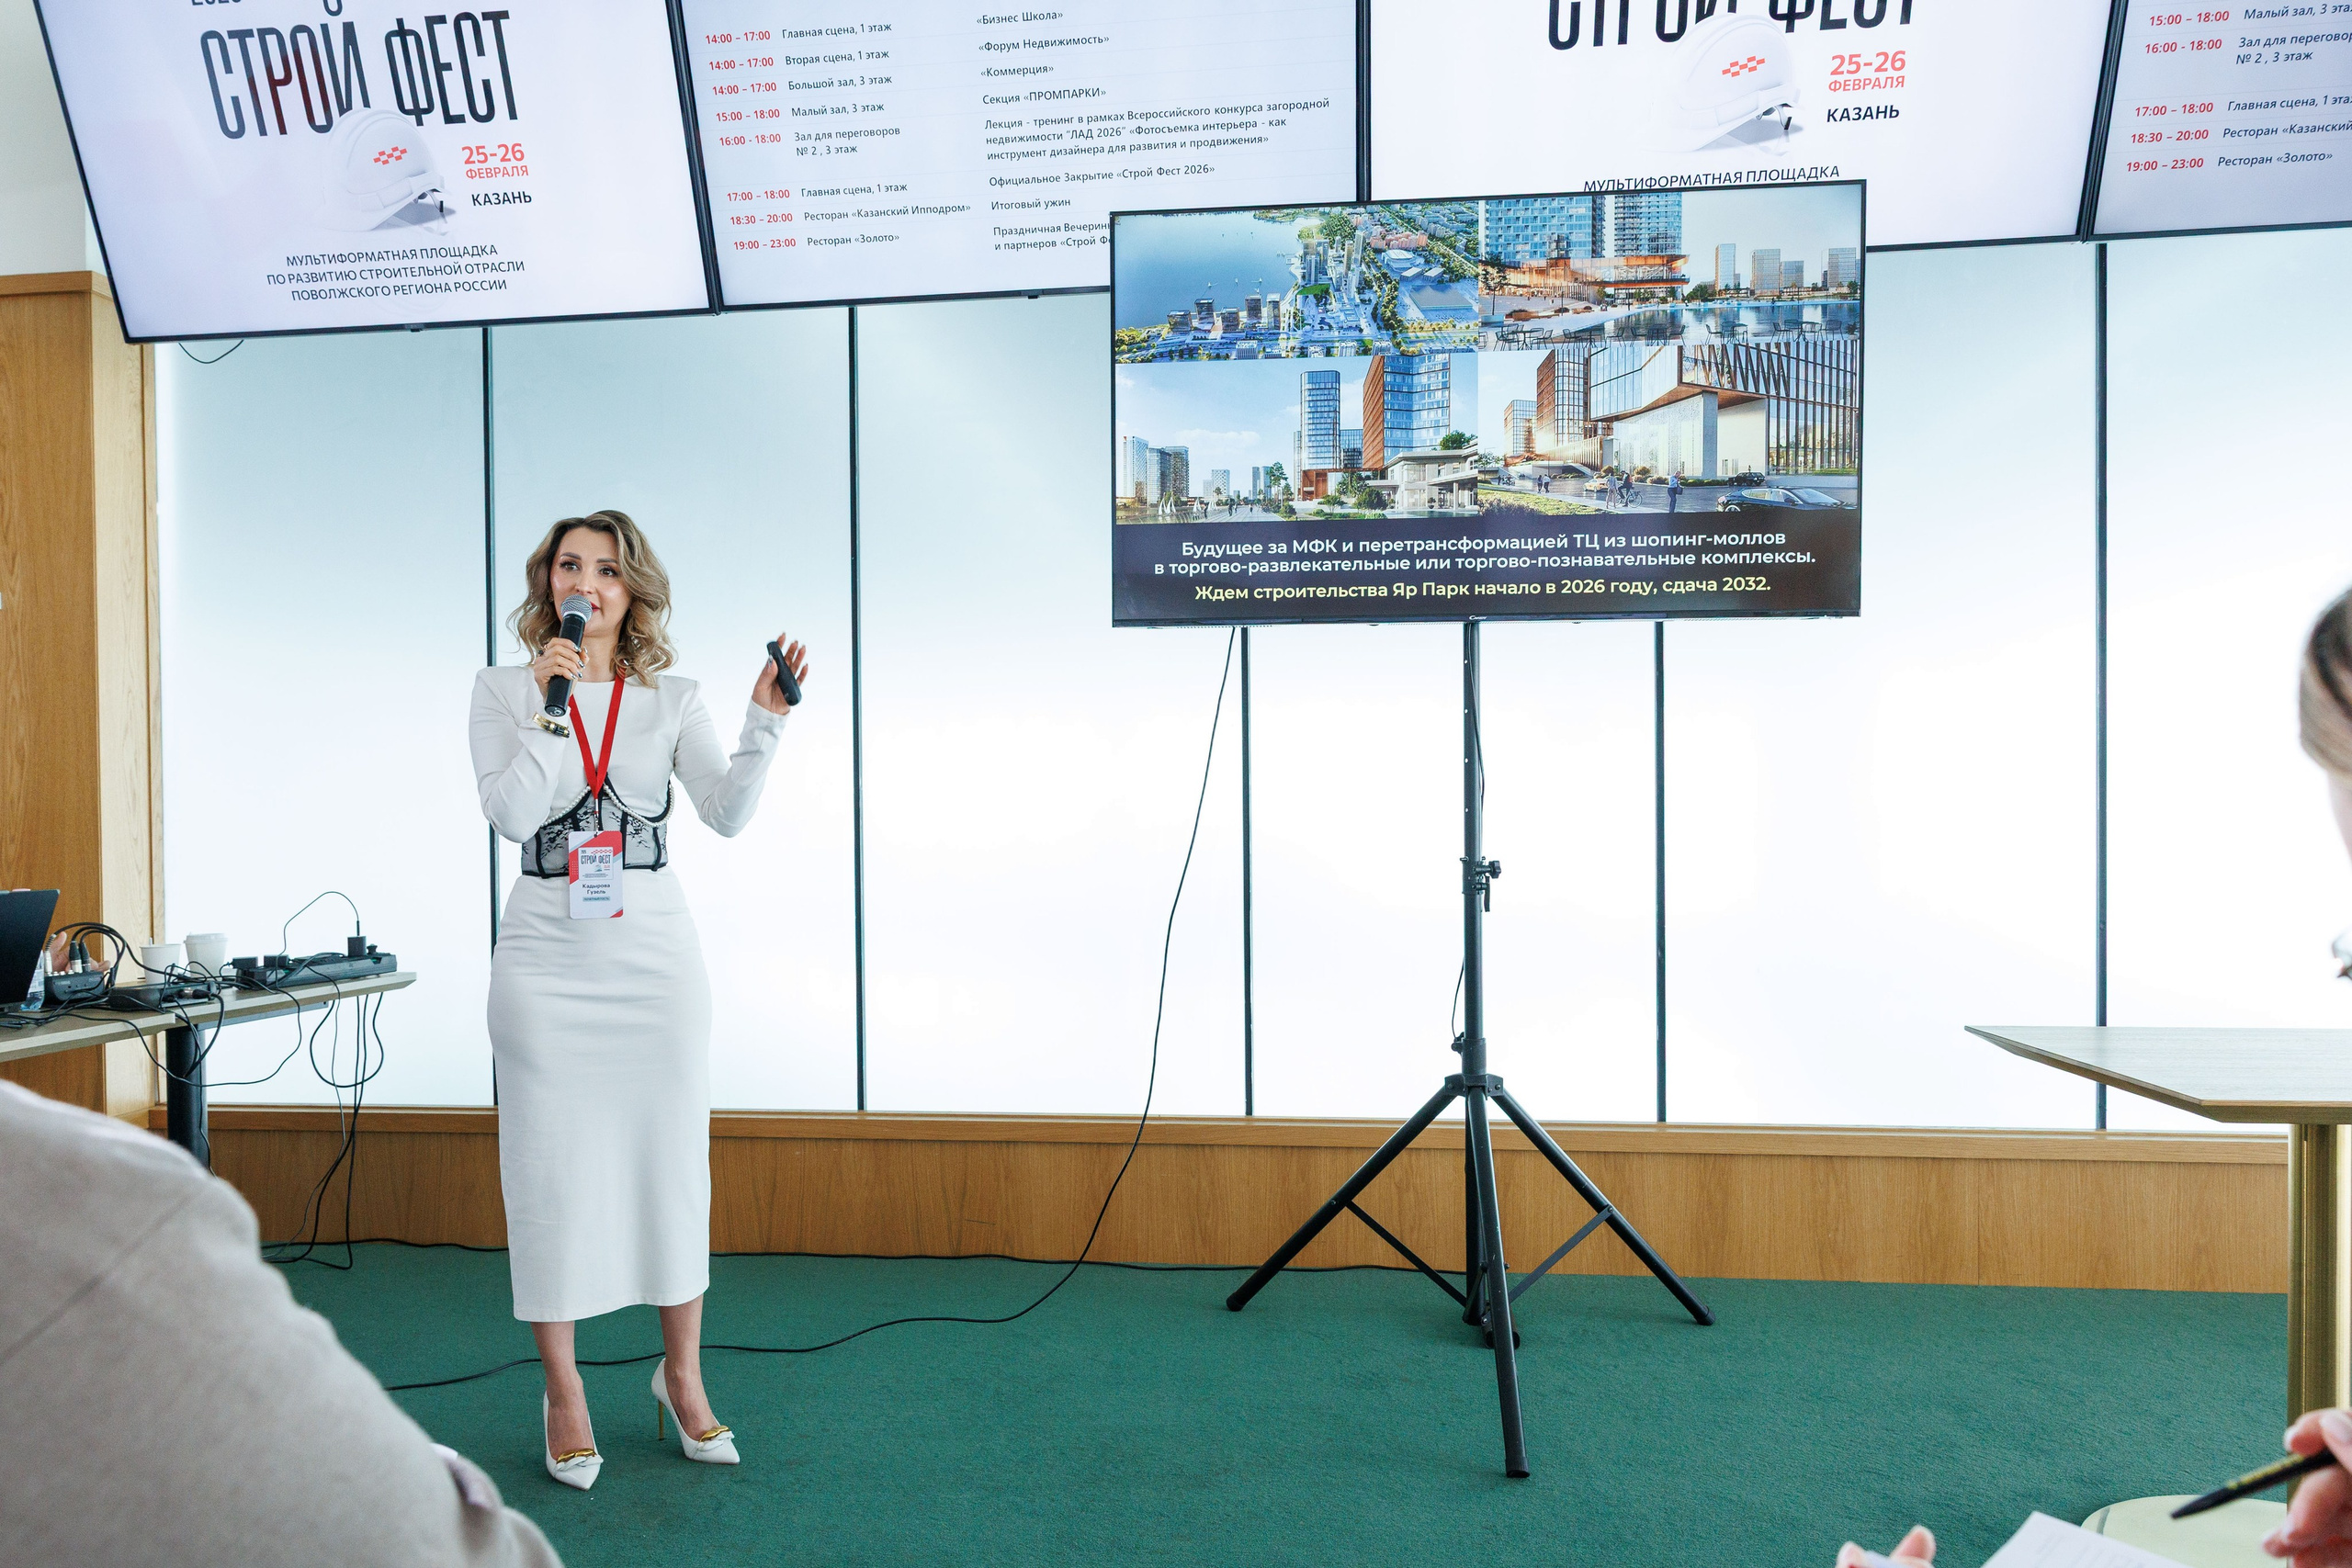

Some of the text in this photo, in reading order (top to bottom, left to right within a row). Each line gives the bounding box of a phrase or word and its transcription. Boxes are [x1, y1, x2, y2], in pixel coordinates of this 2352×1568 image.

[977, 12, 1063, 24] «Бизнес Школа»
[2150, 10, 2230, 26] 15:00 18:00
[2244, 6, 2289, 19] Малый
[2291, 7, 2315, 17] зал,
[706, 30, 770, 44] 14:00 17:00
[782, 23, 891, 39] Главная сцена, 1 этаж
[978, 37, 1109, 53] «Форум Недвижимость»
[2145, 39, 2222, 53] 16:00 18:00
[2239, 37, 2260, 48] Зал
[2263, 37, 2286, 48] для
[709, 57, 774, 70] 14:00 17:00
[785, 51, 889, 66] Вторая сцена, 1 этаж
[1830, 51, 1905, 75] 25-26
[2284, 52, 2313, 62] этаж
[200, 0, 518, 140] СТРОЙ ФЕСТ
[980, 66, 1054, 77] «Коммерция»
[712, 82, 776, 96] 14:00 17:00
[788, 77, 833, 90] Большой
[860, 75, 865, 85] 3
[868, 76, 892, 85] этаж
[1828, 75, 1905, 92] ФЕВРАЛЯ
[982, 87, 1106, 105] Секция «ПРОМПАРКИ»
[791, 105, 827, 117] Малый
[853, 104, 857, 112] 3
[861, 104, 884, 112] этаж
[2135, 102, 2213, 117] 17:00 18:00
[2228, 101, 2277, 110] Главная
[2279, 98, 2318, 109] сцена,
[716, 108, 780, 121] 15:00 18:00
[985, 119, 1023, 130] Лекция
[1034, 117, 1074, 128] тренинг
[1087, 114, 1125, 125] рамках
[1127, 107, 1210, 121] Всероссийского
[1215, 105, 1262, 116] конкурса
[1267, 97, 1329, 112] загородной
[1826, 105, 1899, 122] КАЗАНЬ
[795, 128, 900, 141] Зал для переговоров
[986, 133, 1063, 145] недвижимости
[1129, 124, 1199, 134] «Фотосъемка
[1203, 120, 1257, 132] интерьера
[1269, 118, 1286, 127] как
[2132, 129, 2209, 143] 18:30 20:00
[2223, 128, 2278, 139] Ресторан
[719, 133, 781, 146] 16:00 18:00
[461, 142, 525, 164] 25-26
[811, 146, 817, 155] 2
[826, 145, 831, 154] 3
[834, 146, 857, 154] этаж
[987, 150, 1046, 161] инструмент
[1049, 145, 1104, 158] дизайнера
[1107, 145, 1125, 154] для
[1129, 141, 1176, 153] развития
[1190, 136, 1269, 150] продвижения»
[2127, 158, 2204, 172] 19:00 23:00
[2218, 152, 2333, 167] Ресторан «Золото»
[466, 165, 528, 179] ФЕВРАЛЯ
[989, 164, 1215, 187] Официальное Закрытие «Строй Фест 2026»
[1584, 165, 1839, 191] МУЛЬТИФОРМАТНАЯ ПЛОЩАДКА
[727, 189, 790, 201] 17:00 18:00
[801, 184, 908, 197] Главная сцена, 1 этаж
[471, 191, 532, 206] КАЗАНЬ
[991, 198, 1070, 209] Итоговый ужин
[730, 213, 793, 225] 18:30 20:00
[804, 205, 970, 221] Ресторан «Казанский Ипподром»
[993, 223, 1110, 237] Праздничная Вечерин
[733, 238, 796, 250] 19:00 23:00
[807, 234, 899, 247] Ресторан «Золото»
[1004, 241, 1057, 252] партнеров
[1060, 236, 1095, 248] «Строй
[287, 244, 498, 266] МУЛЬТИФОРМАТНАЯ ПЛОЩАДКА
[266, 261, 525, 285] ПО РАЗВИТИЮ СТРОИТЕЛЬНОЙ ОТРАСЛИ
[291, 279, 507, 300] ПОВОЛЖСКОГО РЕГИОНА РОССИИ
[1182, 534, 1785, 558] Будущее за МФК и перетрансформацией ТЦ из шопинг-моллов
[1155, 552, 1815, 577] в торгово-развлекательные или торгово-познавательные комплексы.
[1195, 577, 1770, 602] Ждем строительства Яр Парк начало в 2026 году, сдача 2032.
